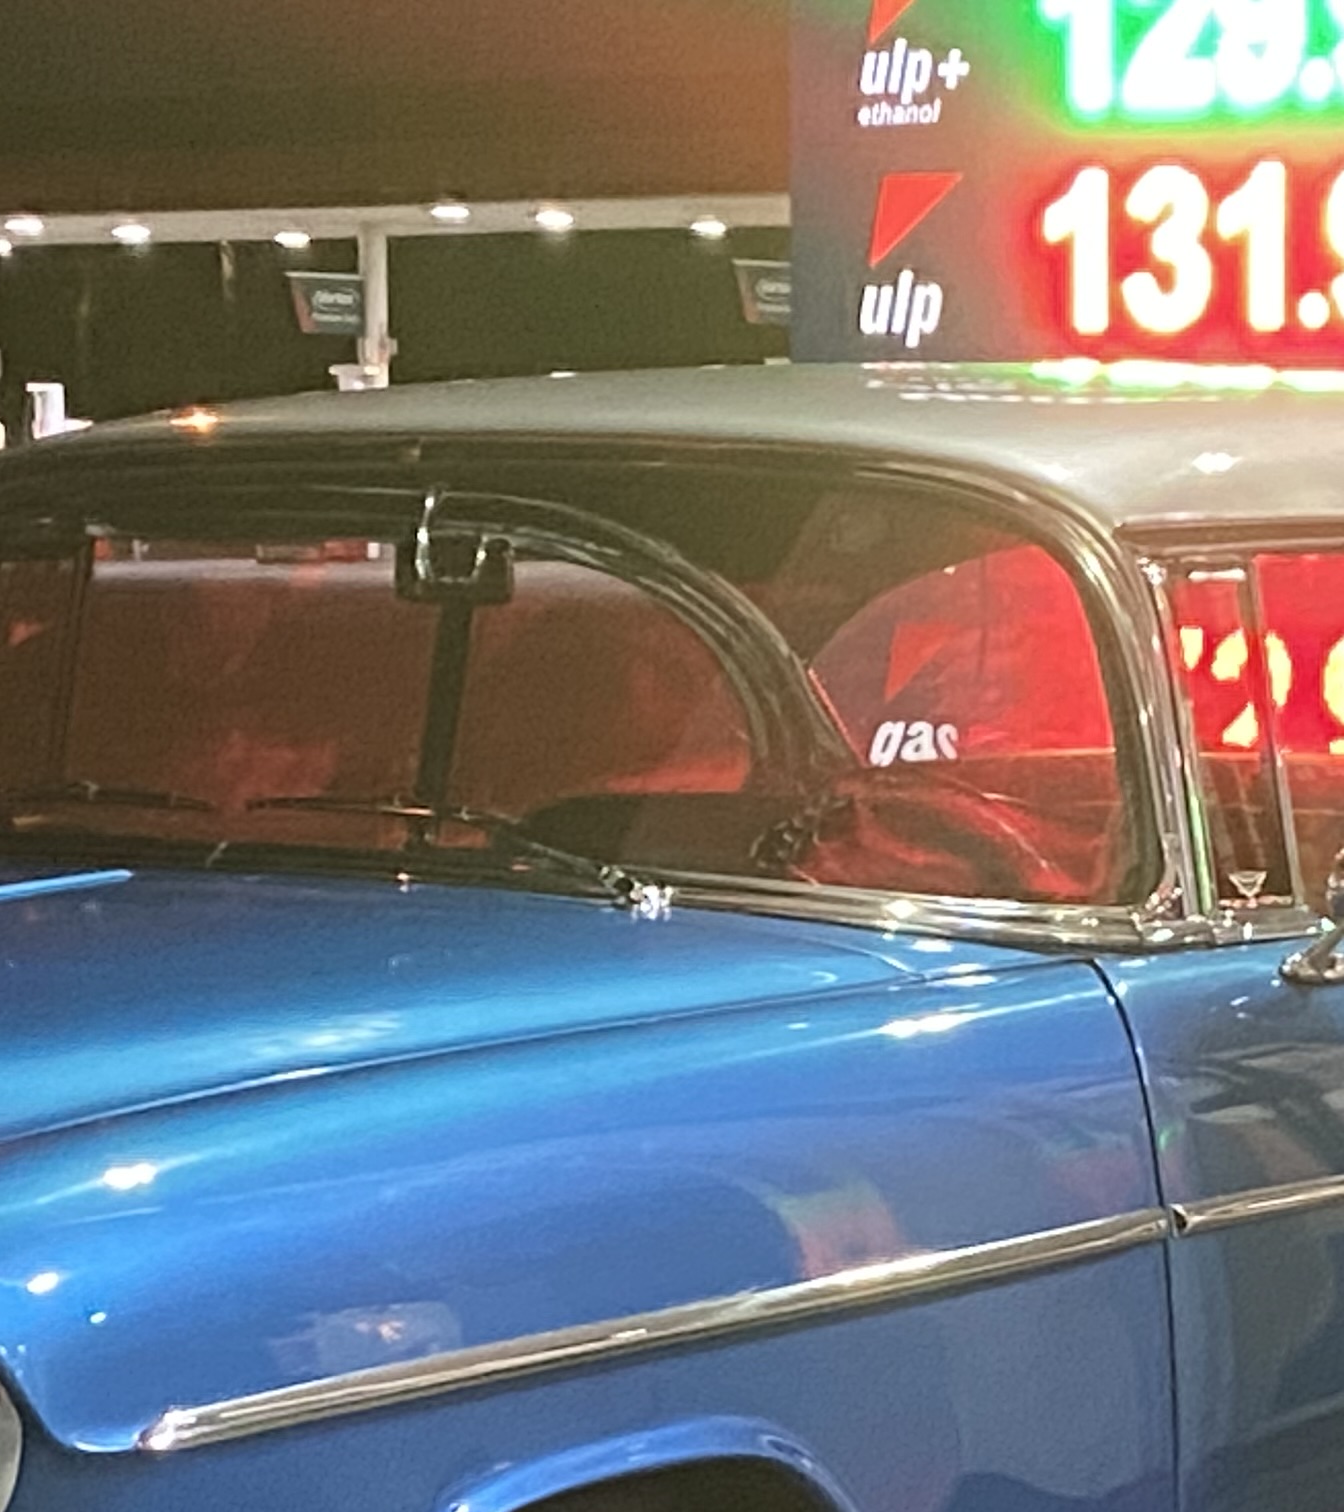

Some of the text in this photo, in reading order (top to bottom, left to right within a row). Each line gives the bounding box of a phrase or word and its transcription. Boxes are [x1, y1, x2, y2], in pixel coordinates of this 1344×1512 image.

[859, 37, 970, 104] ulp+
[857, 98, 942, 126] ethanol
[860, 269, 943, 348] ulp
